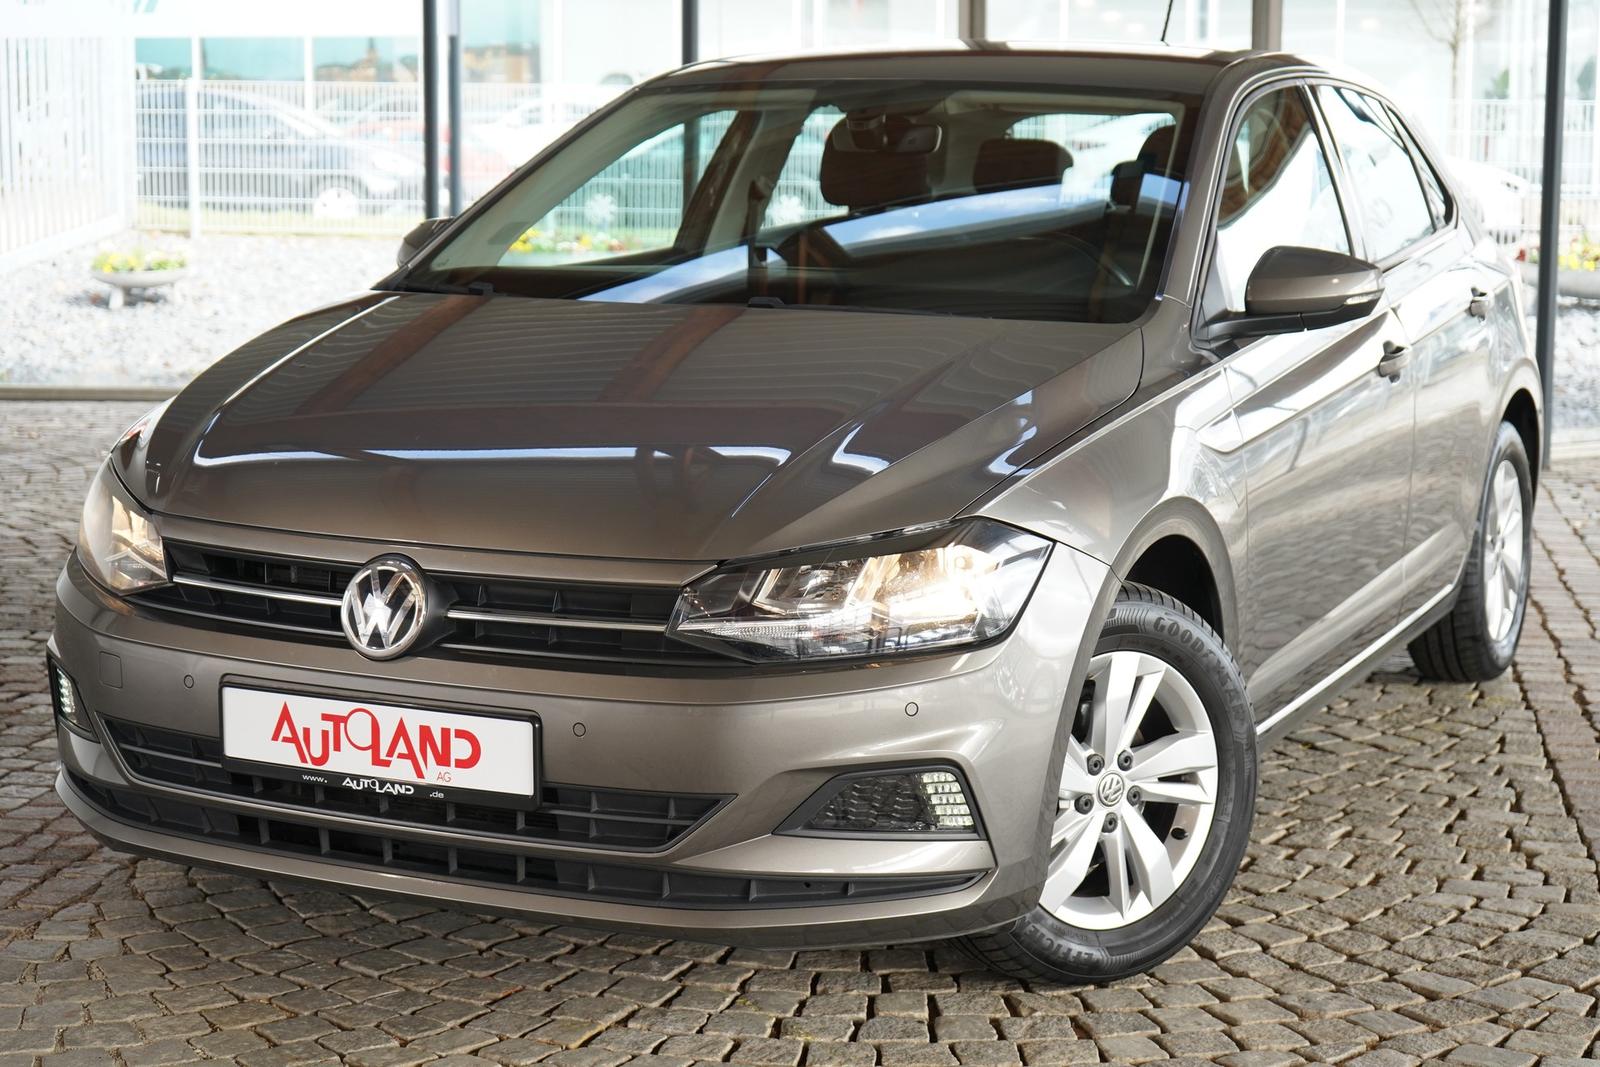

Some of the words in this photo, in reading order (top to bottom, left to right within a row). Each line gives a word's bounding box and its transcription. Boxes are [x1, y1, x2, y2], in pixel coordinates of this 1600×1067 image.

[347, 563, 419, 652] VW
[271, 701, 481, 779] AUTOLAND
[342, 777, 414, 795] AUTOLAND
[436, 771, 452, 783] AG
